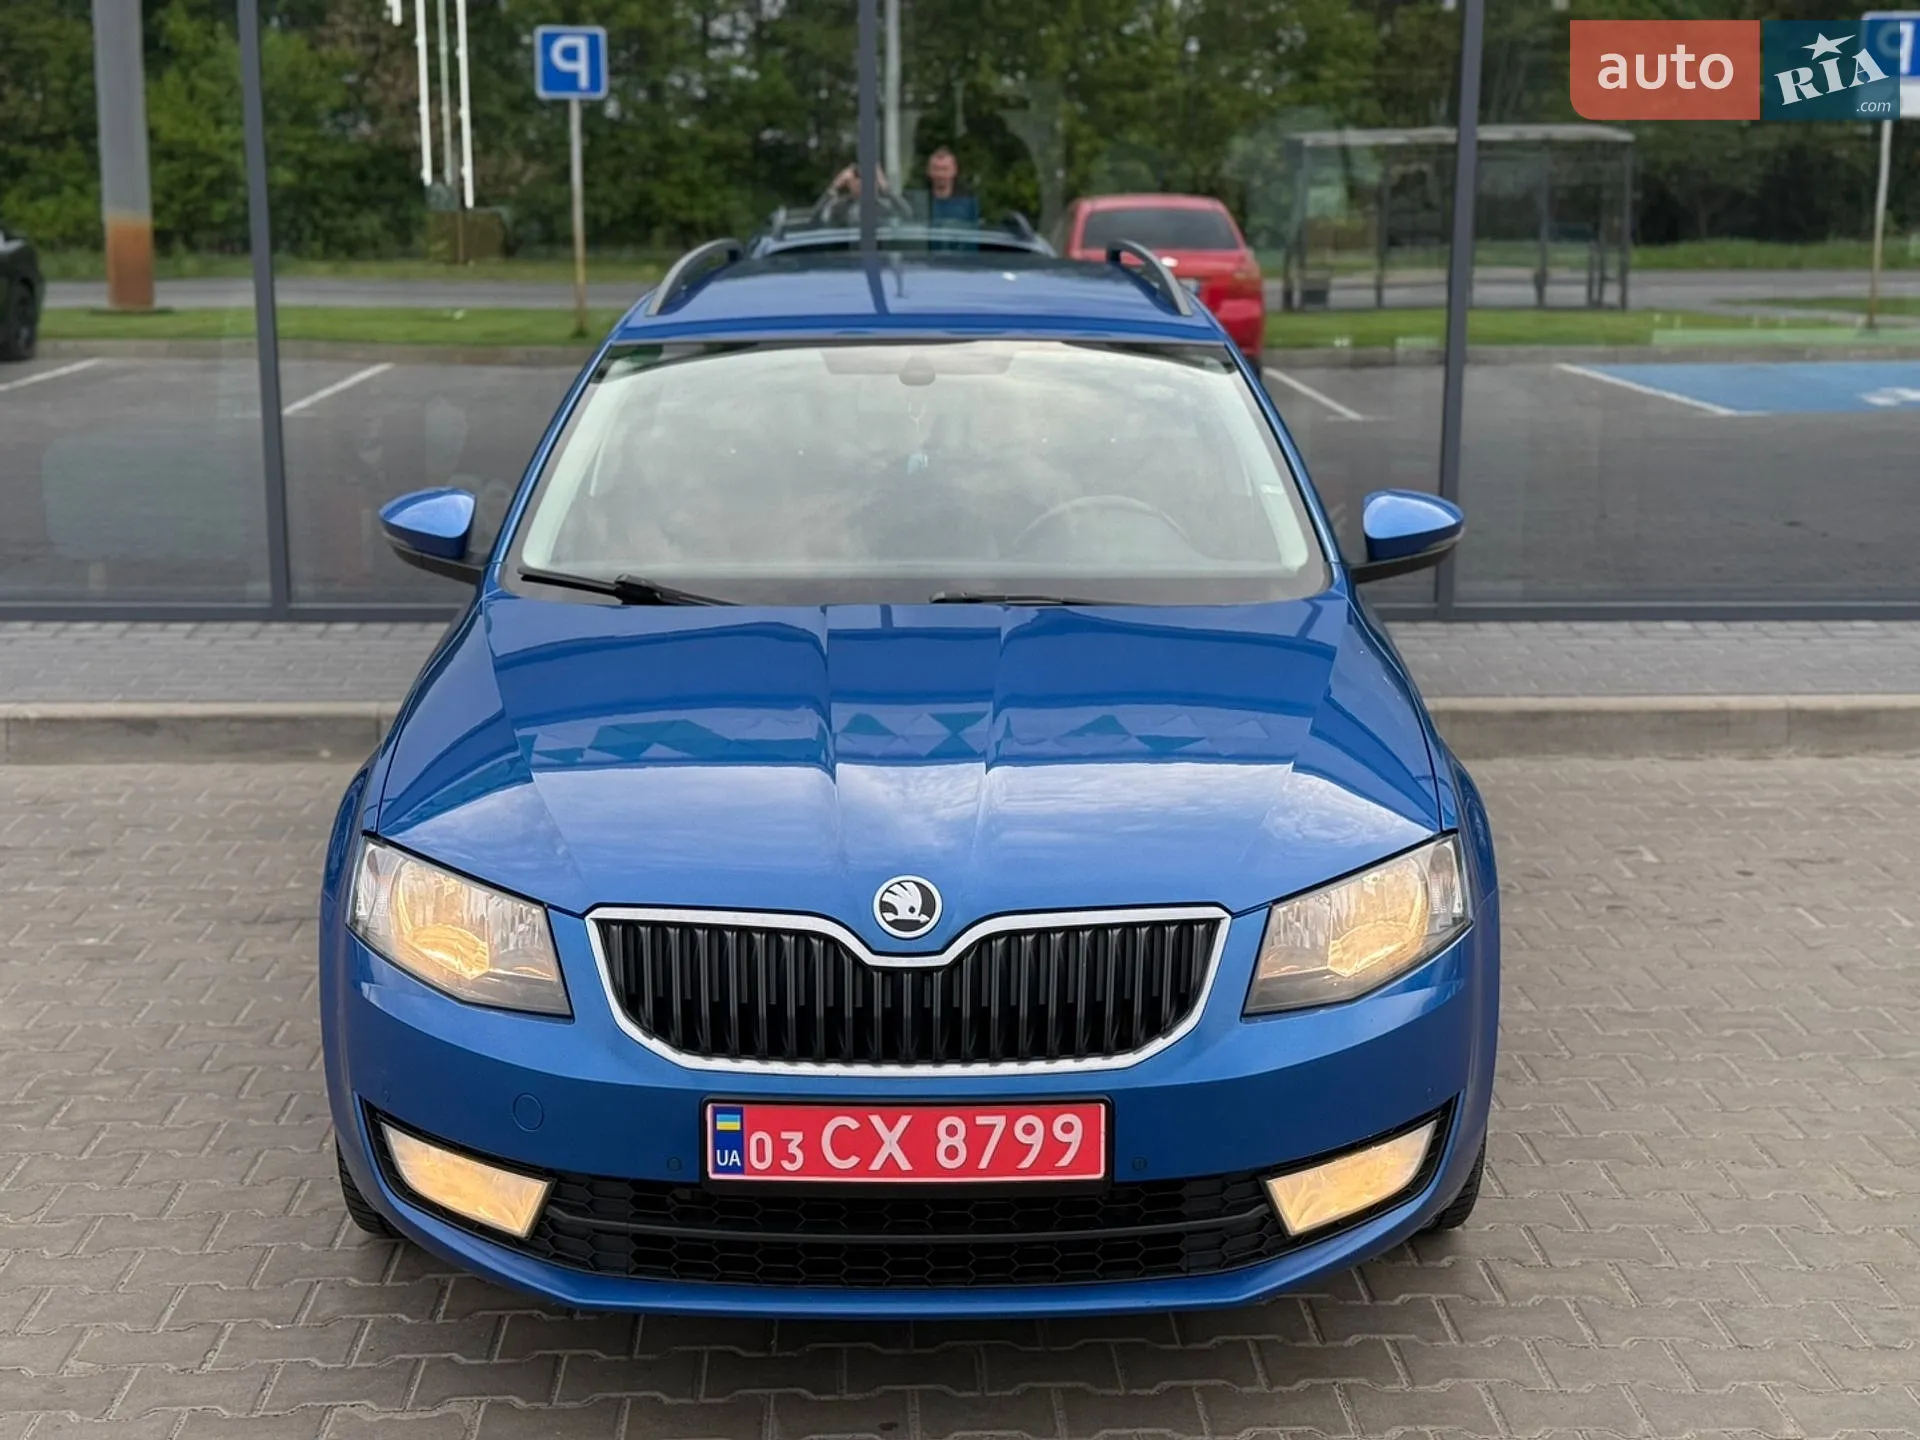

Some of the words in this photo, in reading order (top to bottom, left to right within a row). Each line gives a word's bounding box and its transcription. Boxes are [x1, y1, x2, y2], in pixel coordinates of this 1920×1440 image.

[715, 1148, 742, 1167] UA
[748, 1130, 805, 1172] 03
[820, 1114, 914, 1171] CX
[934, 1112, 1084, 1170] 8799
